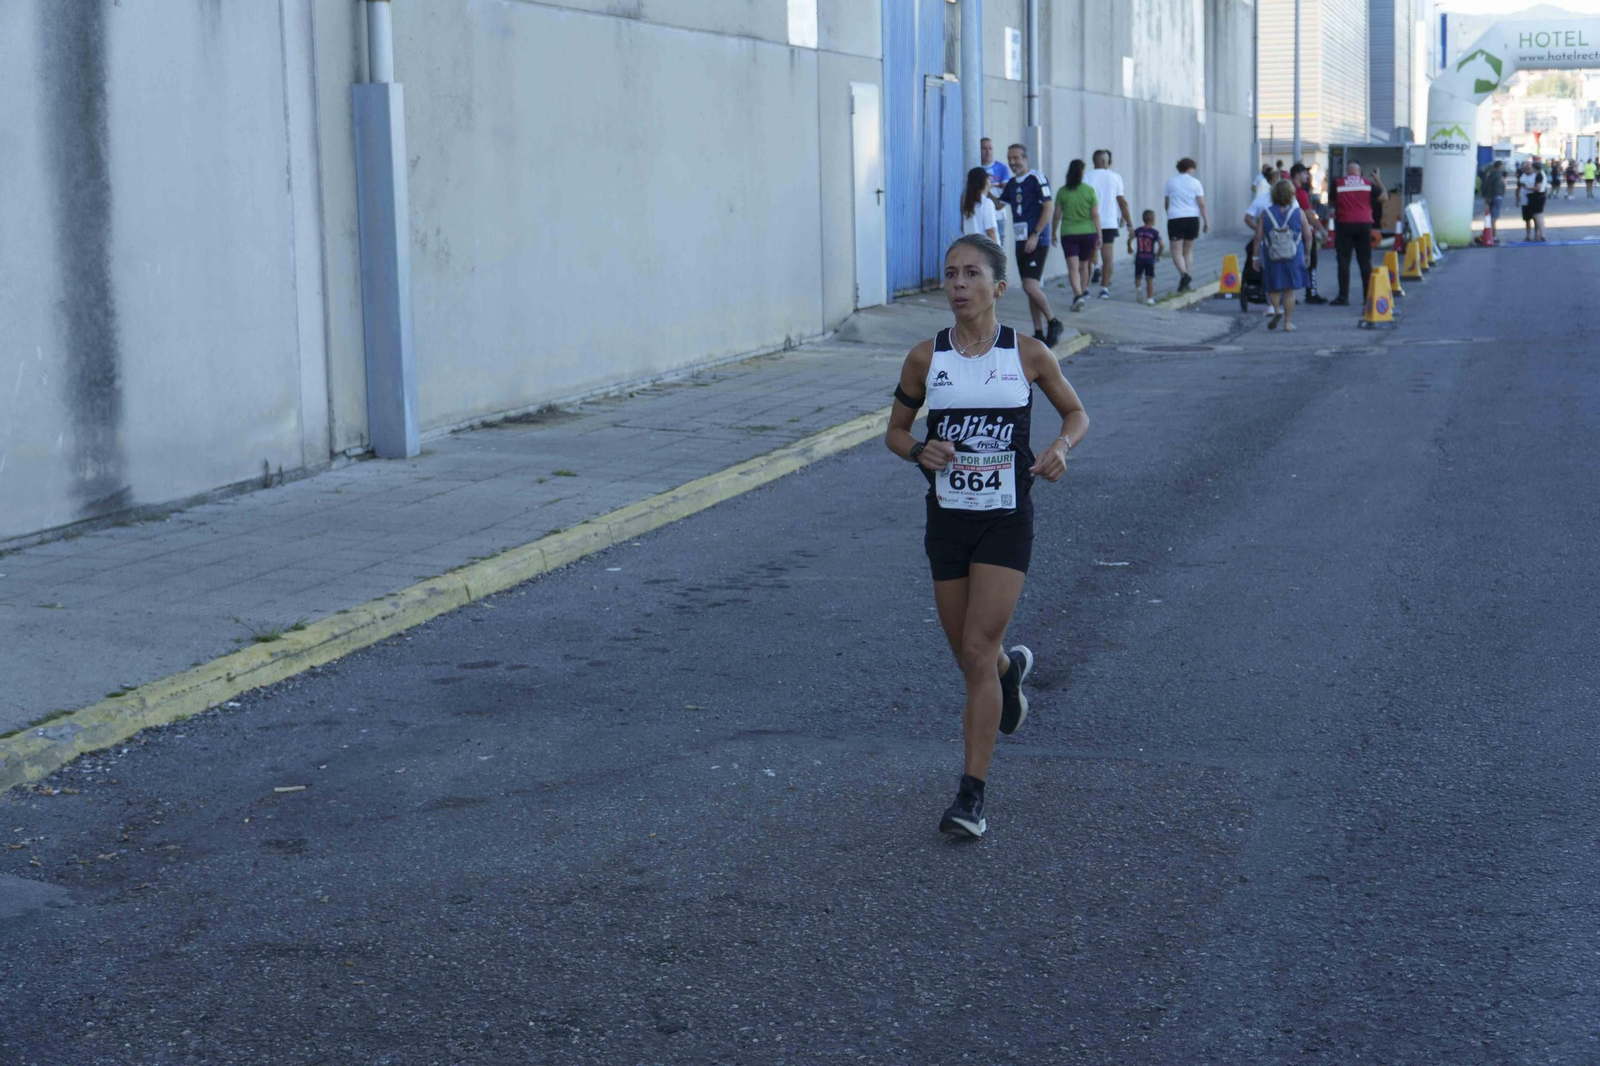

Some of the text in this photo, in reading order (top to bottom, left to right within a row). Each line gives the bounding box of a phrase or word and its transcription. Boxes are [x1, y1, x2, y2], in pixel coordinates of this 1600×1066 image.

[1518, 30, 1590, 49] HOTEL
[1518, 49, 1600, 61] www.hotelrect
[937, 415, 1015, 442] delikia
[977, 441, 1000, 449] fresh
[960, 455, 980, 465] POR
[949, 470, 1002, 492] 664
